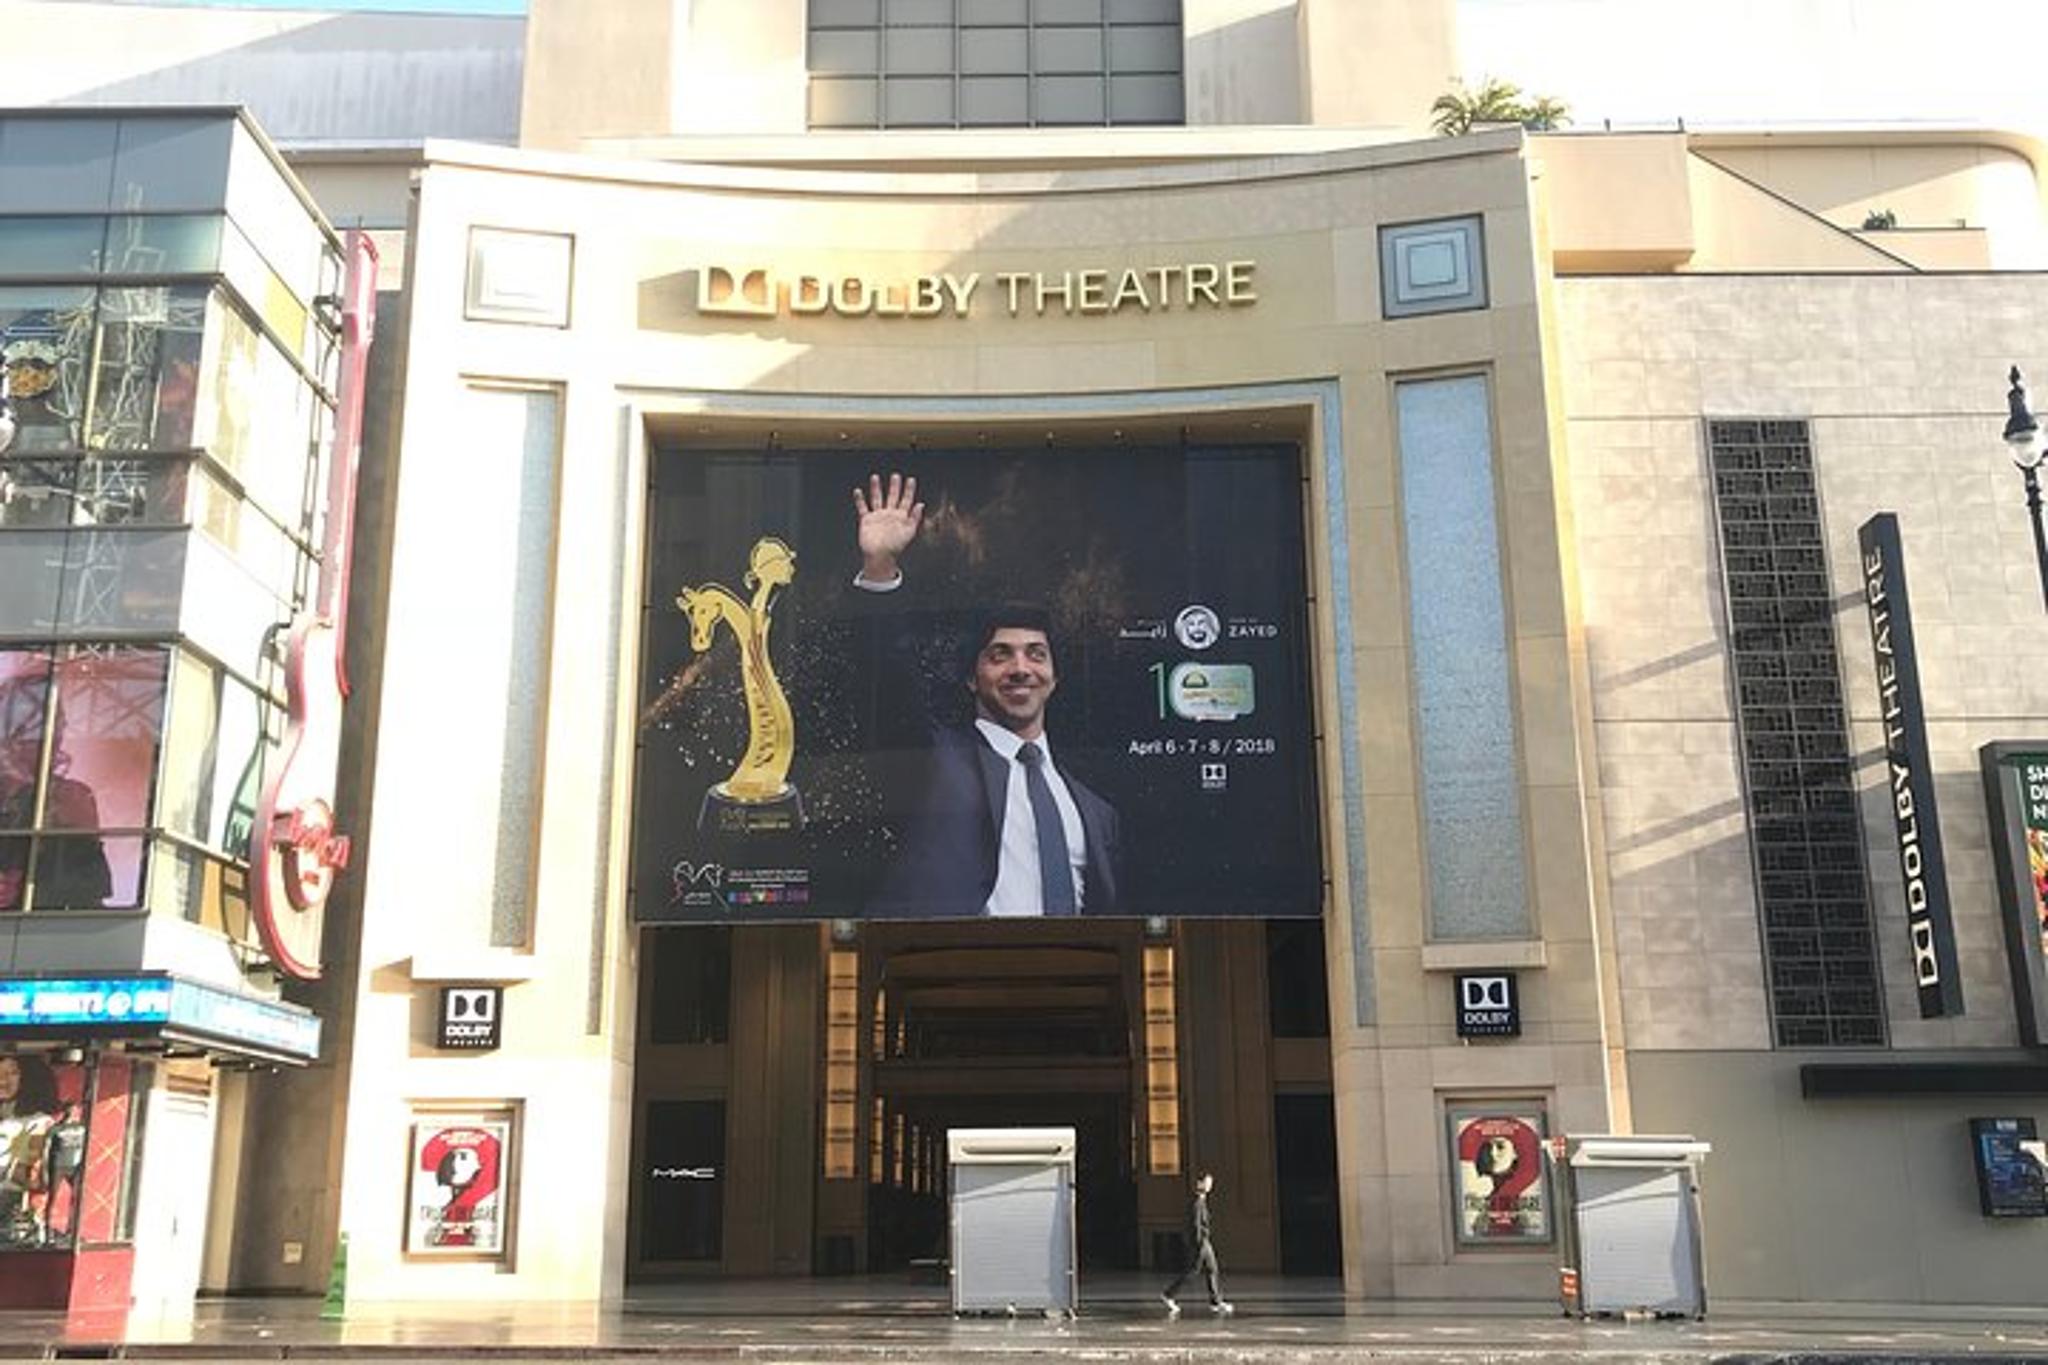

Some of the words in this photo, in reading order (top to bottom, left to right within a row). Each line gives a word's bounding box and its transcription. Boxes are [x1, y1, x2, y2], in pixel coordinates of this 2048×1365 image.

[790, 272, 981, 318] DOLBY
[996, 260, 1259, 316] THEATRE
[1228, 624, 1278, 638] ZAYED
[1864, 545, 1905, 750] THEATRE
[1128, 739, 1163, 756] April
[1235, 739, 1276, 755] 2018
[1892, 763, 1927, 914] DOLBY
[1464, 1011, 1511, 1025] DOLBY
[446, 1024, 493, 1036] DOLBY
